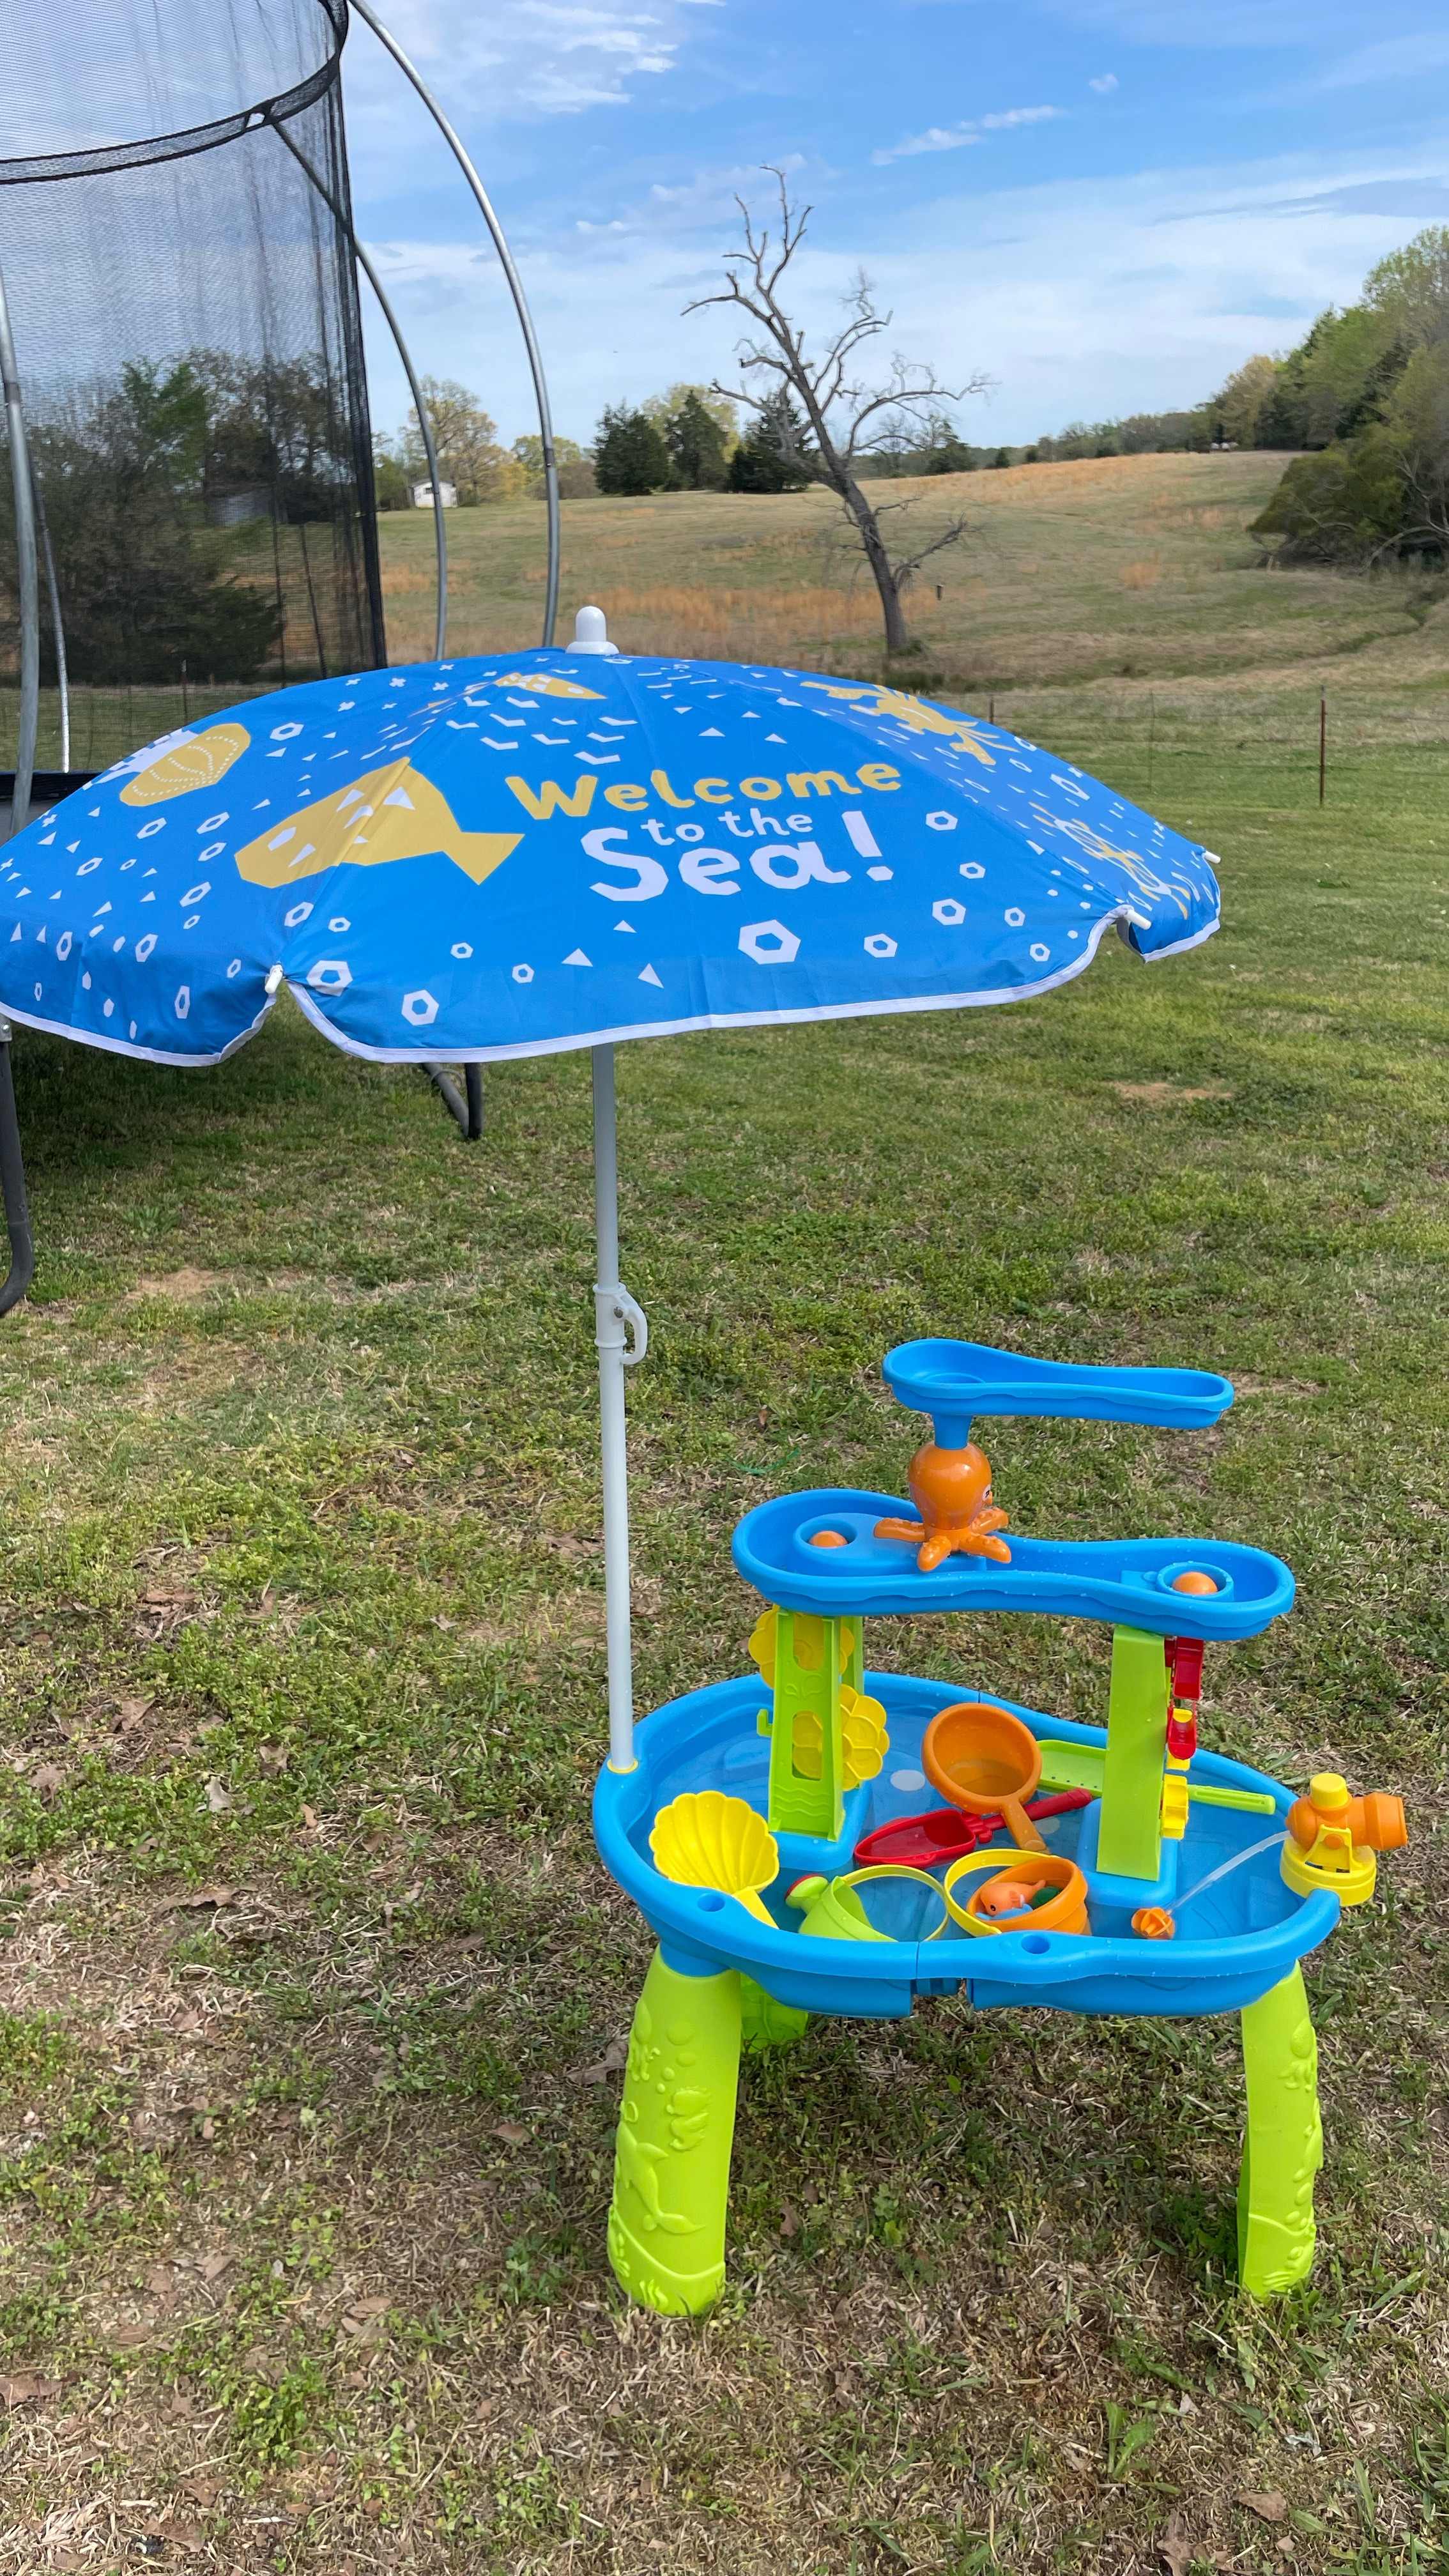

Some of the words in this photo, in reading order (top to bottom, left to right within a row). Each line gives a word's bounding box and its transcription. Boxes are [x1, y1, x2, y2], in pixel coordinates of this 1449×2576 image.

[505, 763, 902, 820] Welcome
[641, 818, 704, 846] to
[717, 808, 813, 837] the
[581, 811, 894, 901] Sea!
